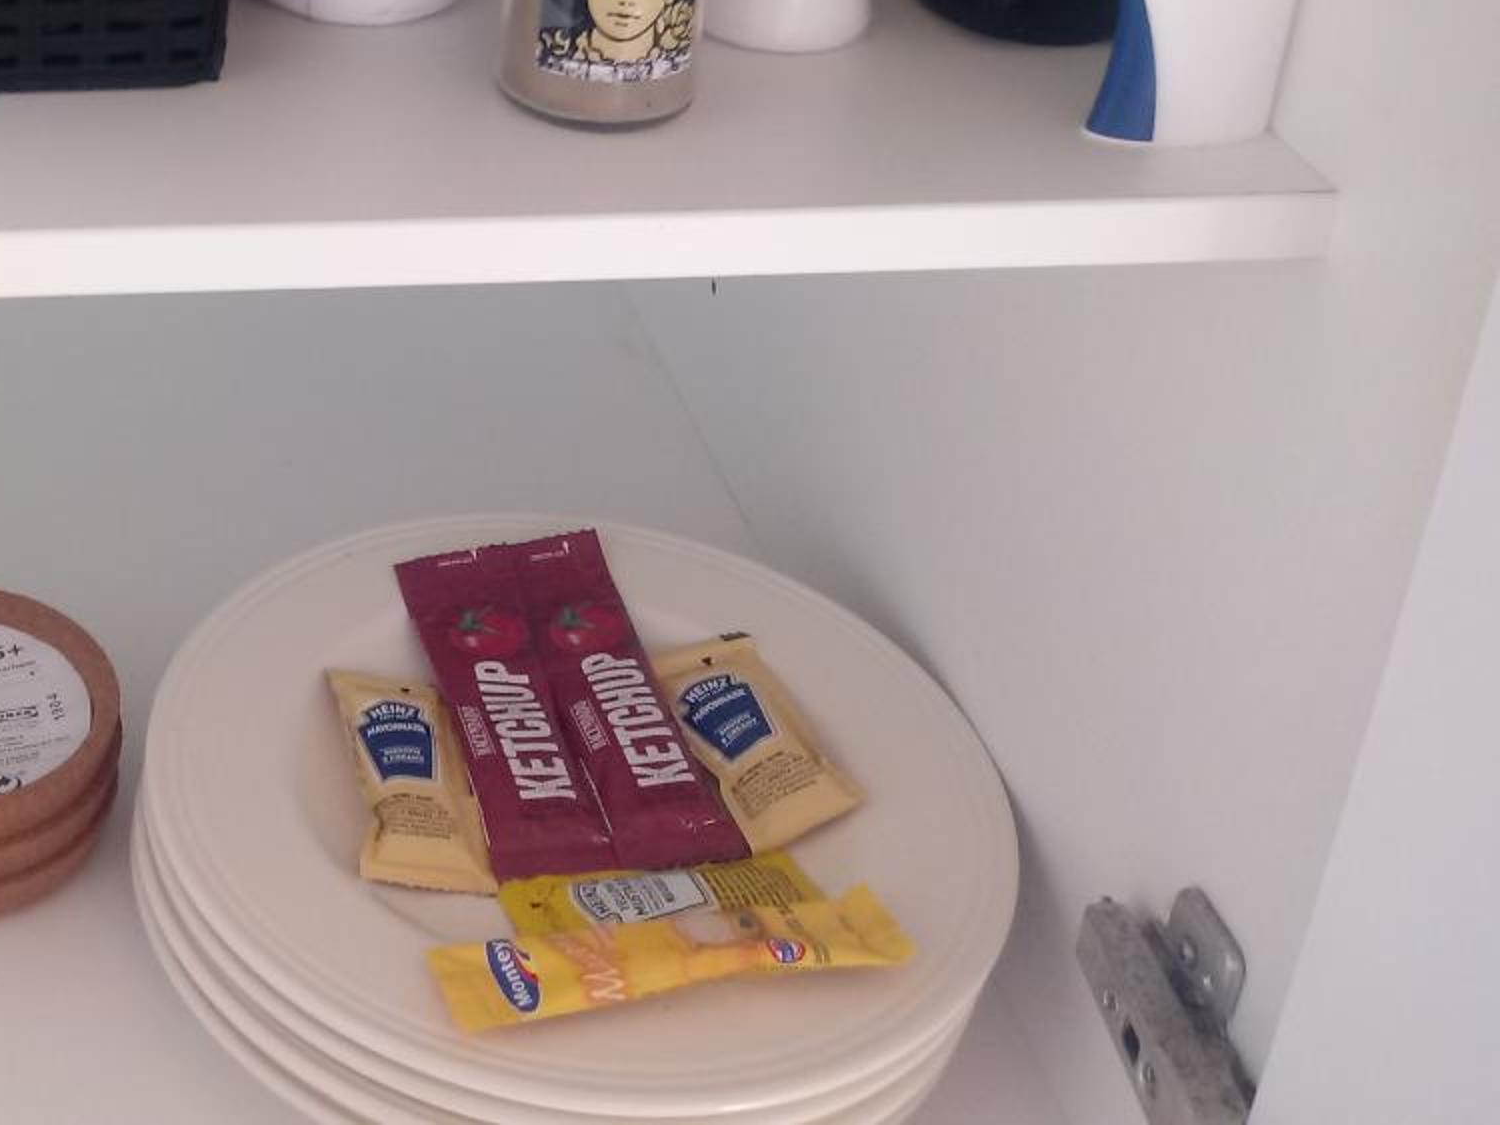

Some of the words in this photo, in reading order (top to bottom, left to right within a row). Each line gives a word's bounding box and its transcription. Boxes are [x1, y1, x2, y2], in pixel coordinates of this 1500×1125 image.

[371, 701, 415, 719] HEINZ
[580, 651, 696, 787] KETCHUP
[685, 676, 730, 705] HEINZ
[473, 660, 577, 800] KETCHUP
[493, 939, 533, 1009] Montey
